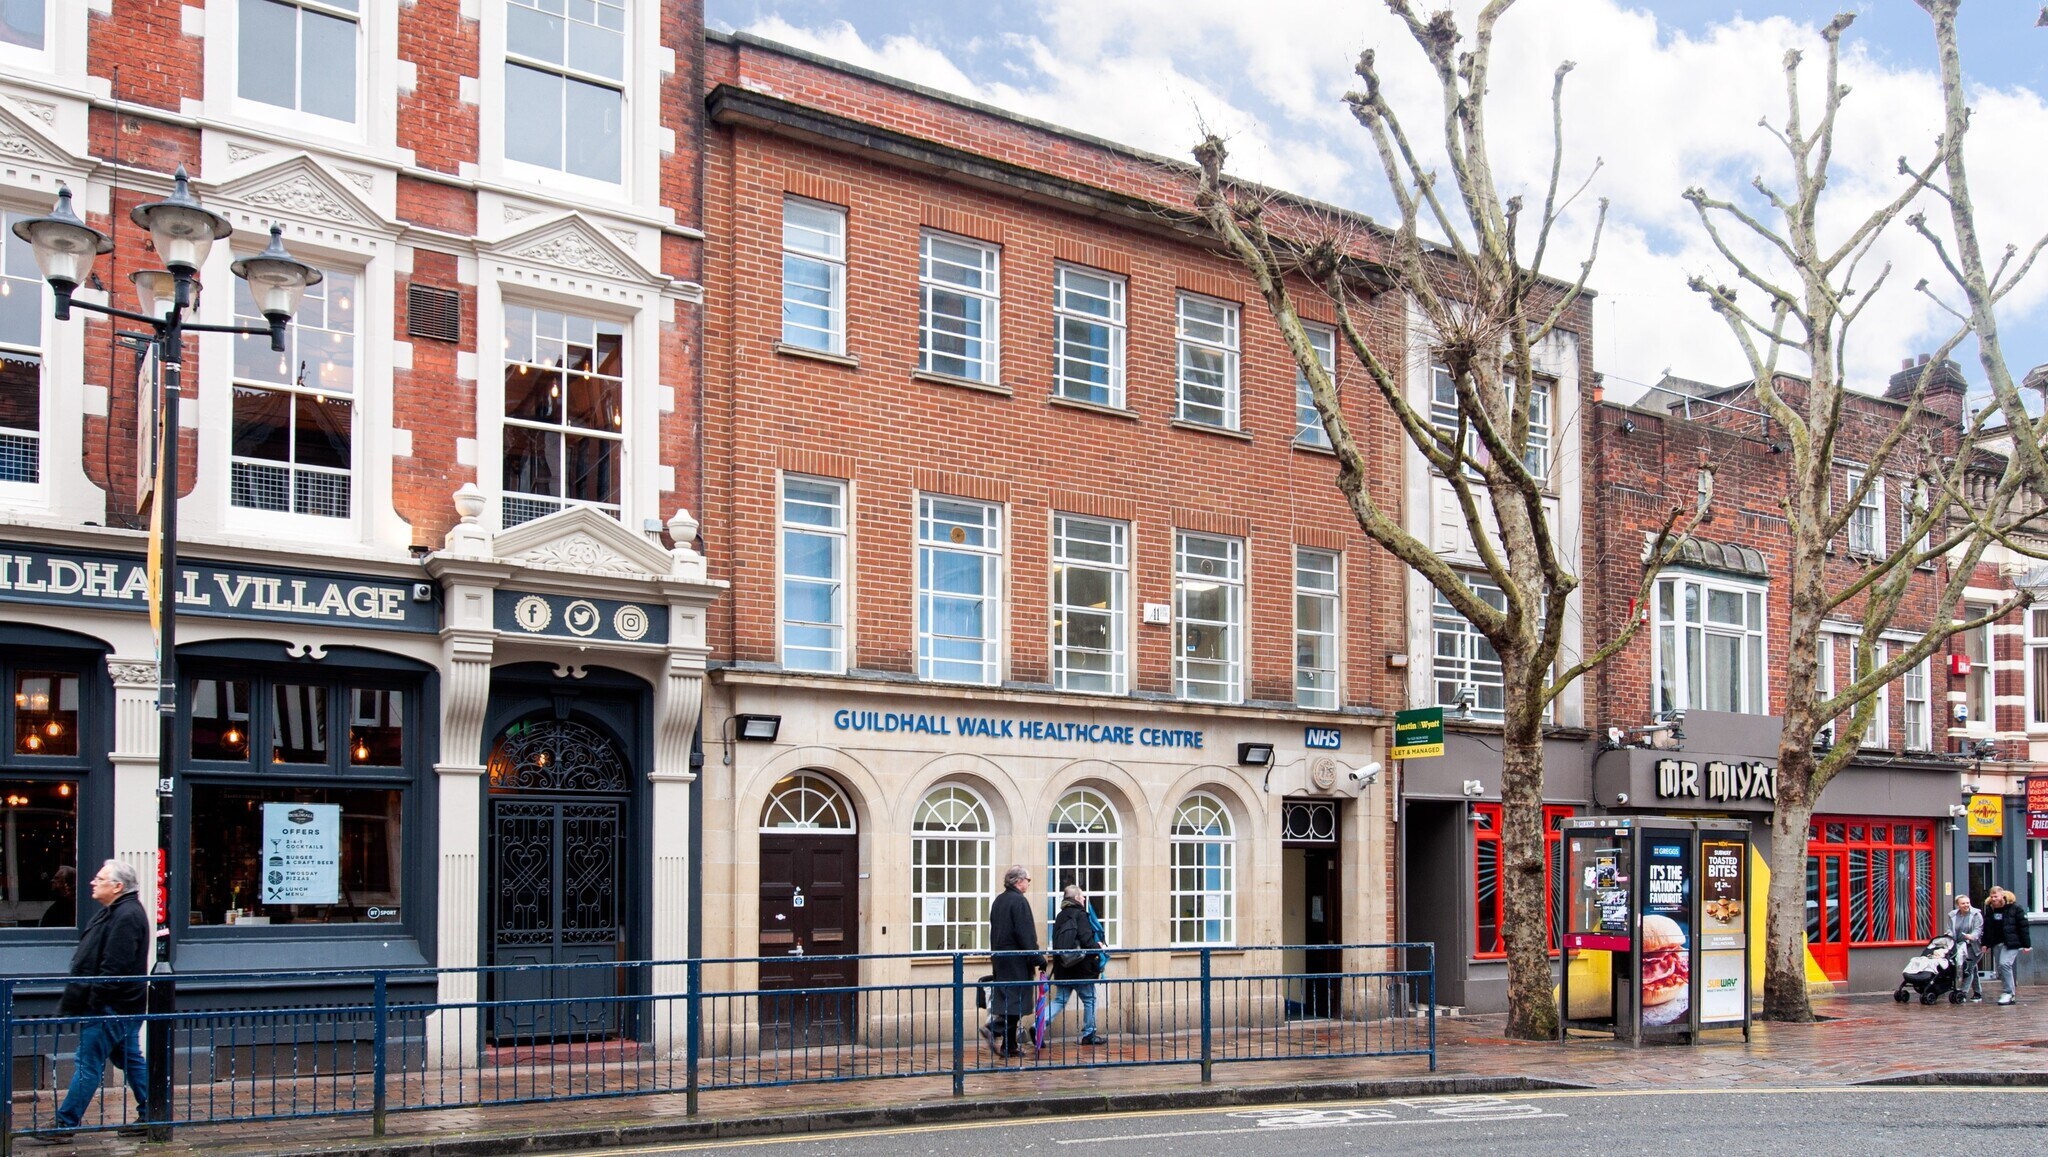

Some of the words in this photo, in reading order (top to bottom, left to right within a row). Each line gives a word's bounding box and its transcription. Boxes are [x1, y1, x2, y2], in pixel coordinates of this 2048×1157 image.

[213, 573, 405, 621] VILLAGE
[834, 709, 950, 736] GUILDHALL
[956, 717, 1013, 739] WALK
[1019, 720, 1134, 745] HEALTHCARE
[1139, 728, 1204, 749] CENTRE
[1396, 723, 1416, 731] Austin
[1421, 720, 1440, 729] Wyatt
[1307, 729, 1340, 747] NHS
[1655, 758, 1699, 798] MR
[1704, 760, 1778, 802] MIYA
[1709, 857, 1738, 865] TOASTED
[1650, 865, 1666, 880] IT'S
[1666, 865, 1683, 880] THE
[1708, 865, 1738, 878] BITES
[1650, 880, 1682, 893] NATION'S
[1650, 892, 1683, 904] FAVOURITE
[1707, 978, 1738, 988] SUBWAY
